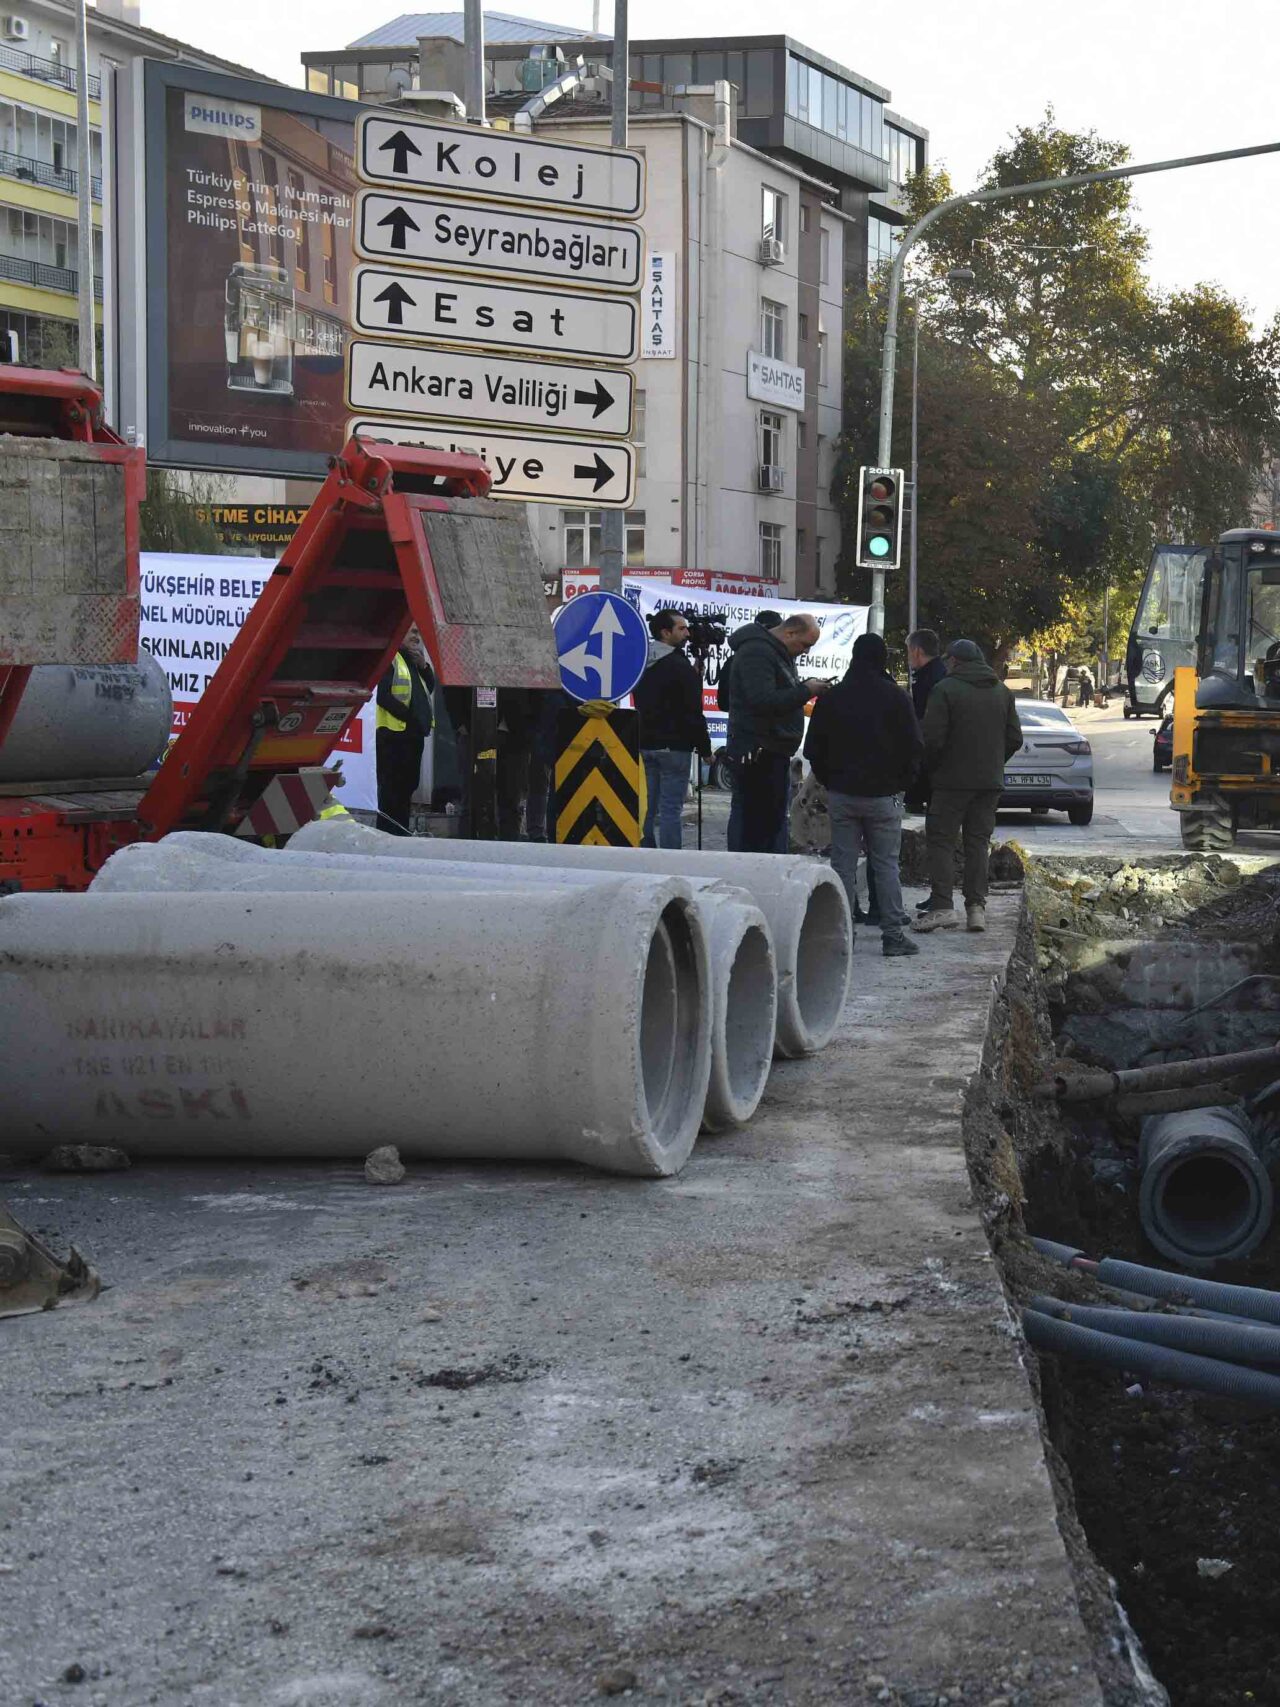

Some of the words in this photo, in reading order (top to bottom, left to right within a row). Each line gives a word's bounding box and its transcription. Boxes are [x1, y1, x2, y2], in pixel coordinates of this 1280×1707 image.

[191, 106, 255, 130] PHILIPS
[436, 142, 584, 200] Kolej
[187, 169, 270, 195] Türkiye'nin
[284, 186, 351, 208] Numaralı
[187, 190, 251, 212] Espresso
[256, 201, 319, 223] Makinesi
[187, 210, 237, 231] Philips
[241, 218, 302, 240] LatteGo!
[434, 214, 627, 270] Seyranbağları
[435, 293, 564, 336] Esat
[651, 271, 663, 346] ŞAHTAŞ
[299, 328, 314, 340] 12
[368, 362, 473, 400] Ankara
[485, 374, 567, 417] Valiliği
[761, 368, 802, 394] ŞAHTAŞ
[188, 422, 237, 435] innovation
[250, 430, 267, 438] you
[869, 467, 895, 475] 2081
[281, 717, 300, 728] 70
